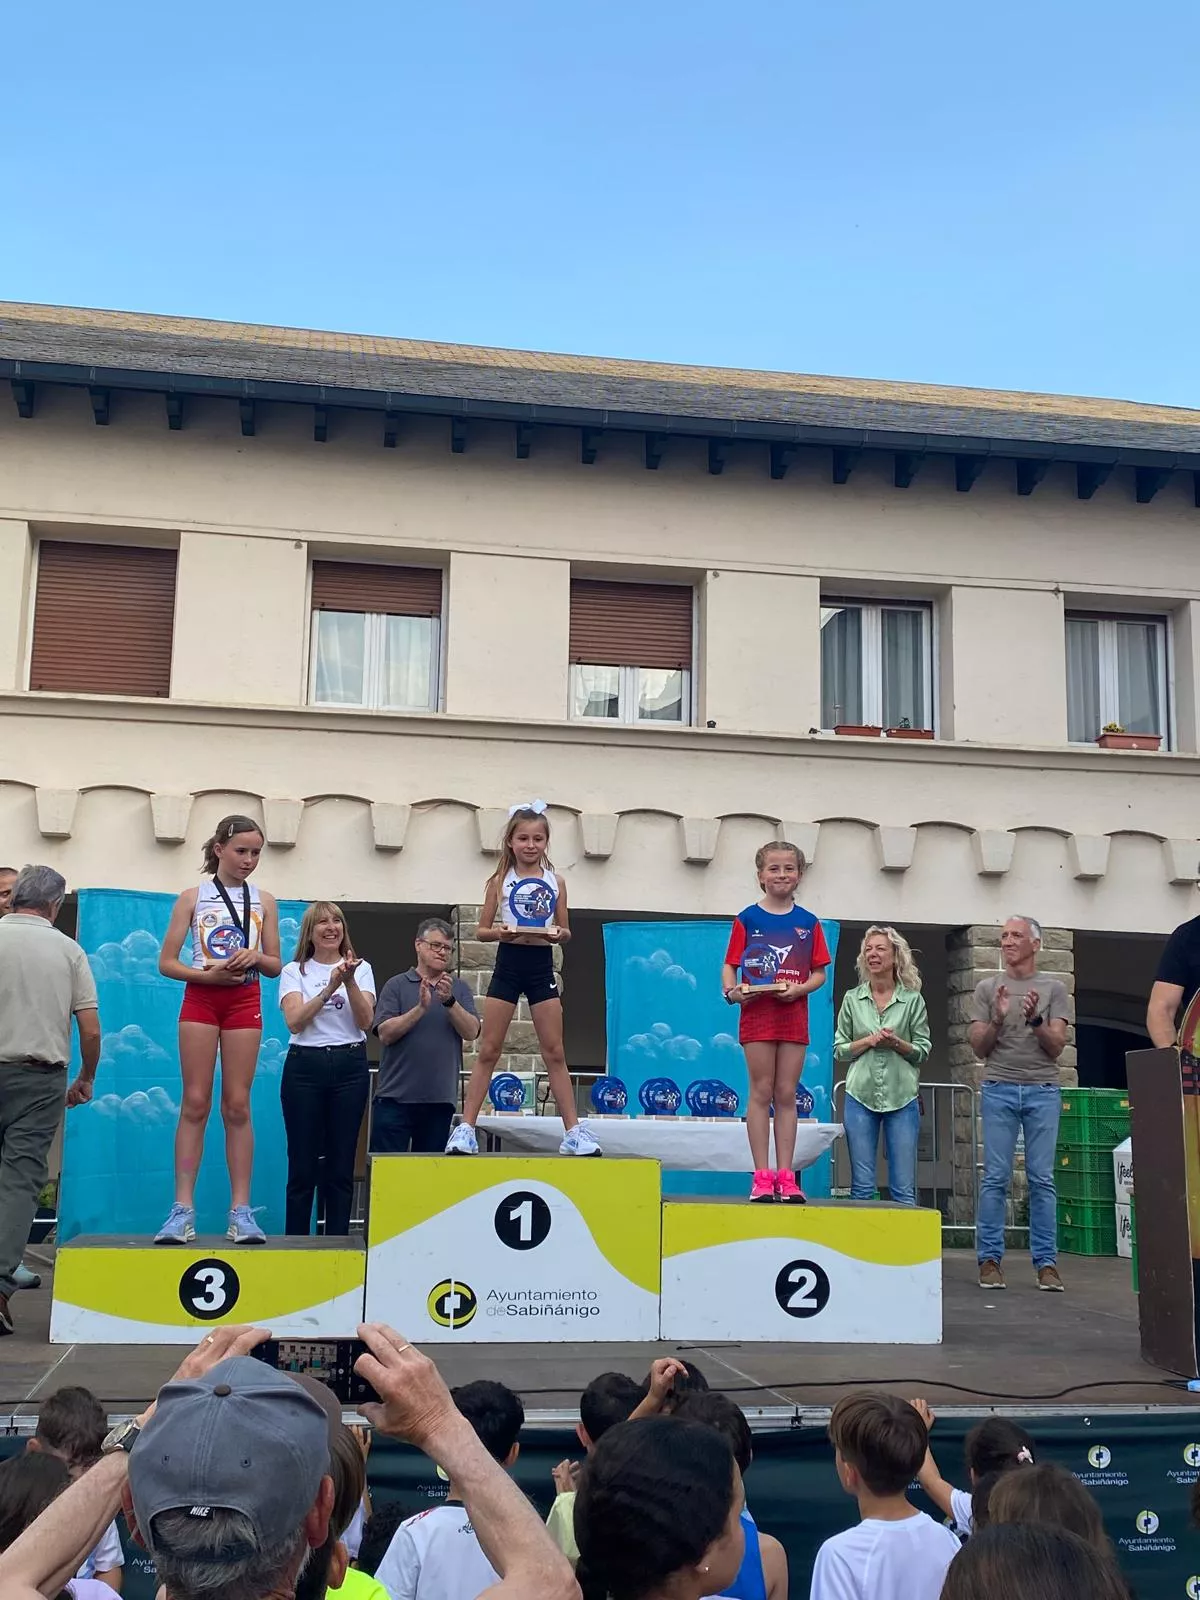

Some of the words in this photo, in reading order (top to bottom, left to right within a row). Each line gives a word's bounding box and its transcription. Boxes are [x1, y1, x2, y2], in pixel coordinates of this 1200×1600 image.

[510, 1200, 533, 1241] 1
[191, 1267, 226, 1311] 3
[787, 1268, 818, 1309] 2
[486, 1289, 598, 1303] Ayuntamiento
[190, 1506, 210, 1517] NIKE
[1118, 1537, 1175, 1545] Ayuntamiento
[1128, 1544, 1176, 1552] Sabiñánigo
